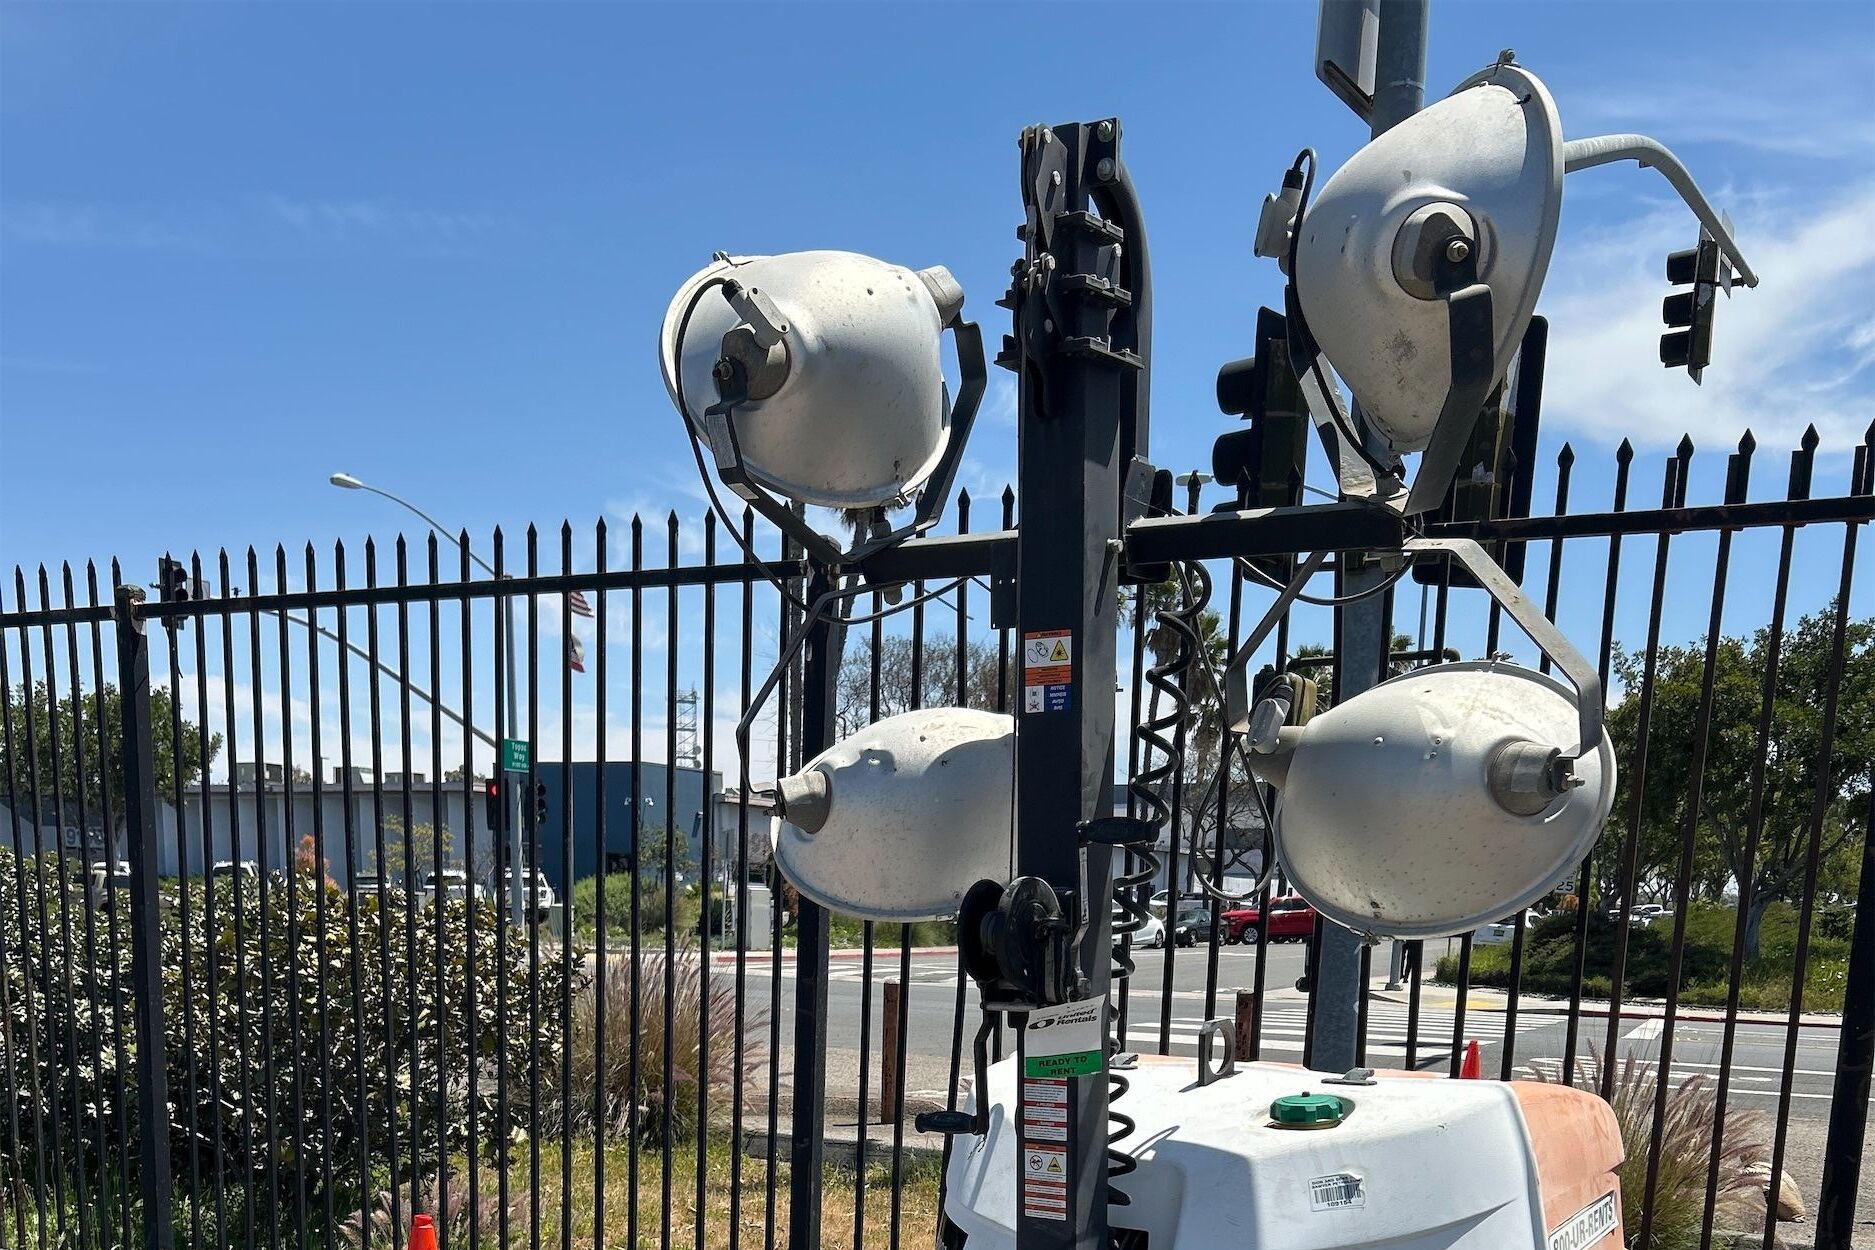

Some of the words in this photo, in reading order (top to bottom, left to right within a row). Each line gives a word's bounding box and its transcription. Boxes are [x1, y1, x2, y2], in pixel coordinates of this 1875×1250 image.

[513, 752, 525, 762] Way
[1557, 881, 1574, 891] 25
[1056, 1015, 1098, 1025] Rentals
[1039, 1057, 1071, 1067] READY
[1074, 1055, 1087, 1063] TO
[1050, 1067, 1076, 1075] RENT
